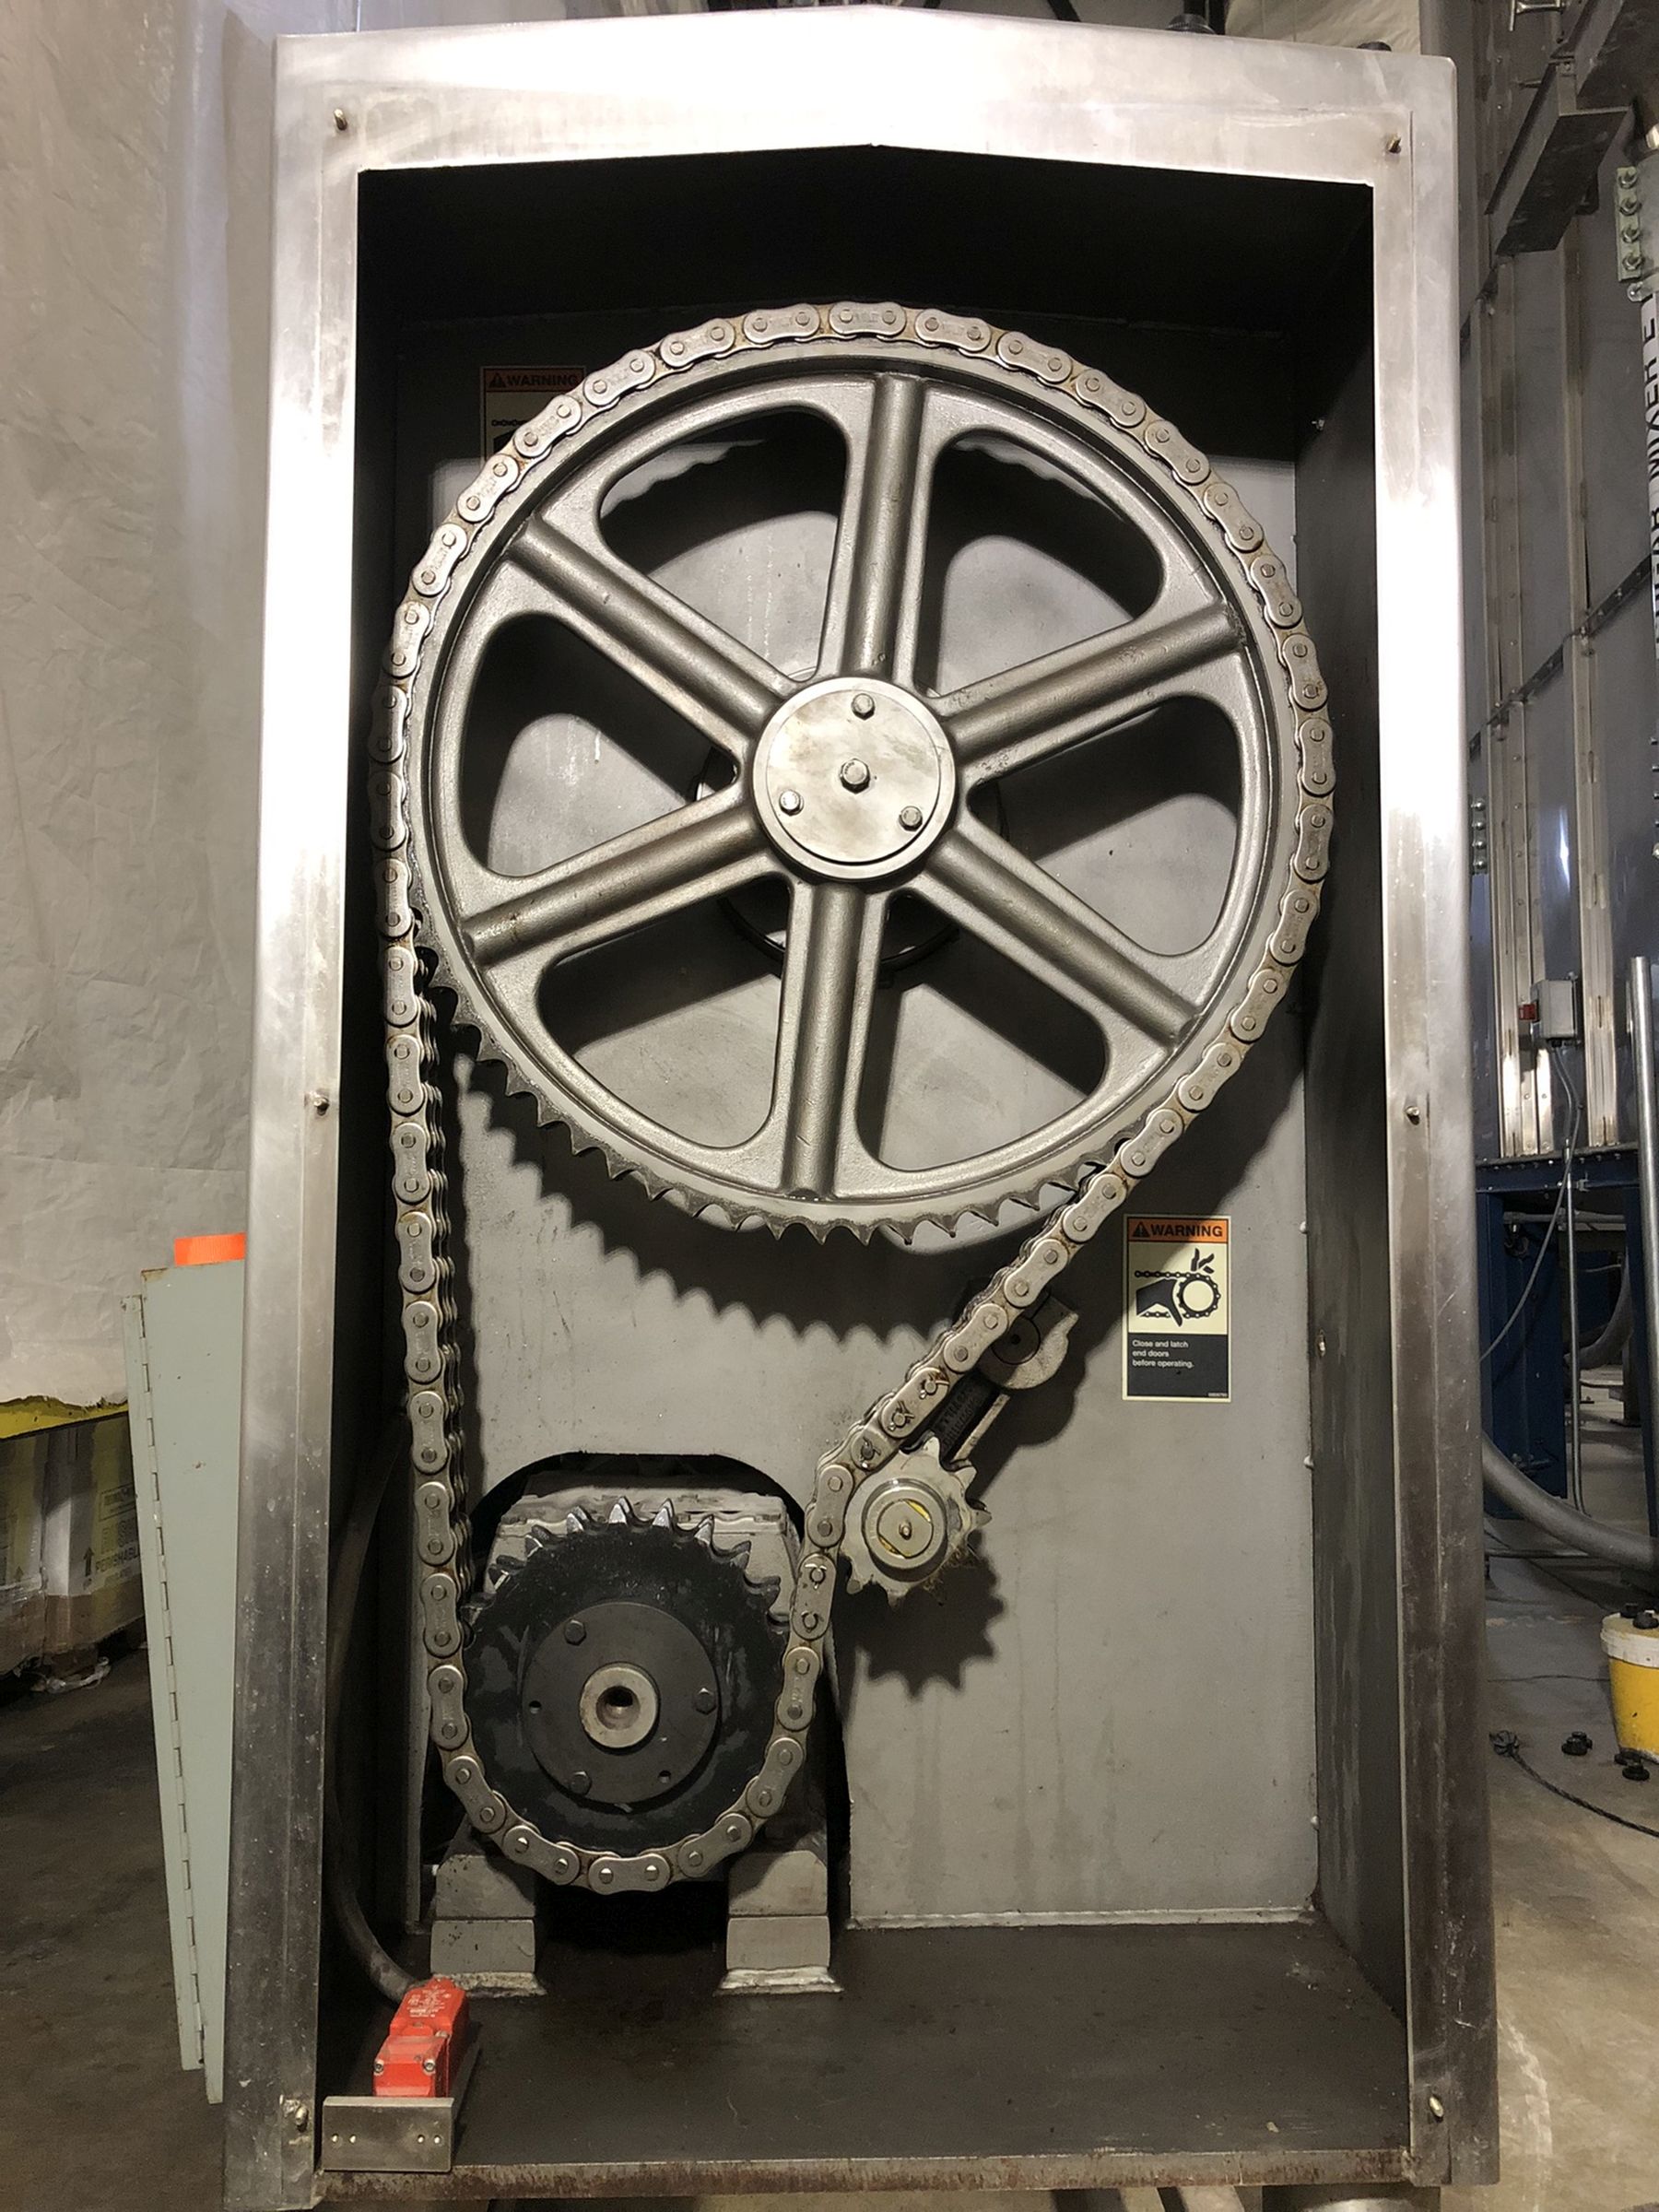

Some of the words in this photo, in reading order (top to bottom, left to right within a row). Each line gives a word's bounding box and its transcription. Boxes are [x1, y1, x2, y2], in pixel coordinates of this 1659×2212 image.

[506, 374, 579, 386] WARNING
[1150, 1223, 1223, 1237] WARNING
[1132, 1339, 1153, 1347] Close
[1154, 1340, 1170, 1348] and
[1170, 1340, 1189, 1348] latch
[1132, 1349, 1147, 1358] end
[1147, 1349, 1170, 1358] doors
[1132, 1359, 1157, 1367] before
[1157, 1360, 1195, 1370] operating.
